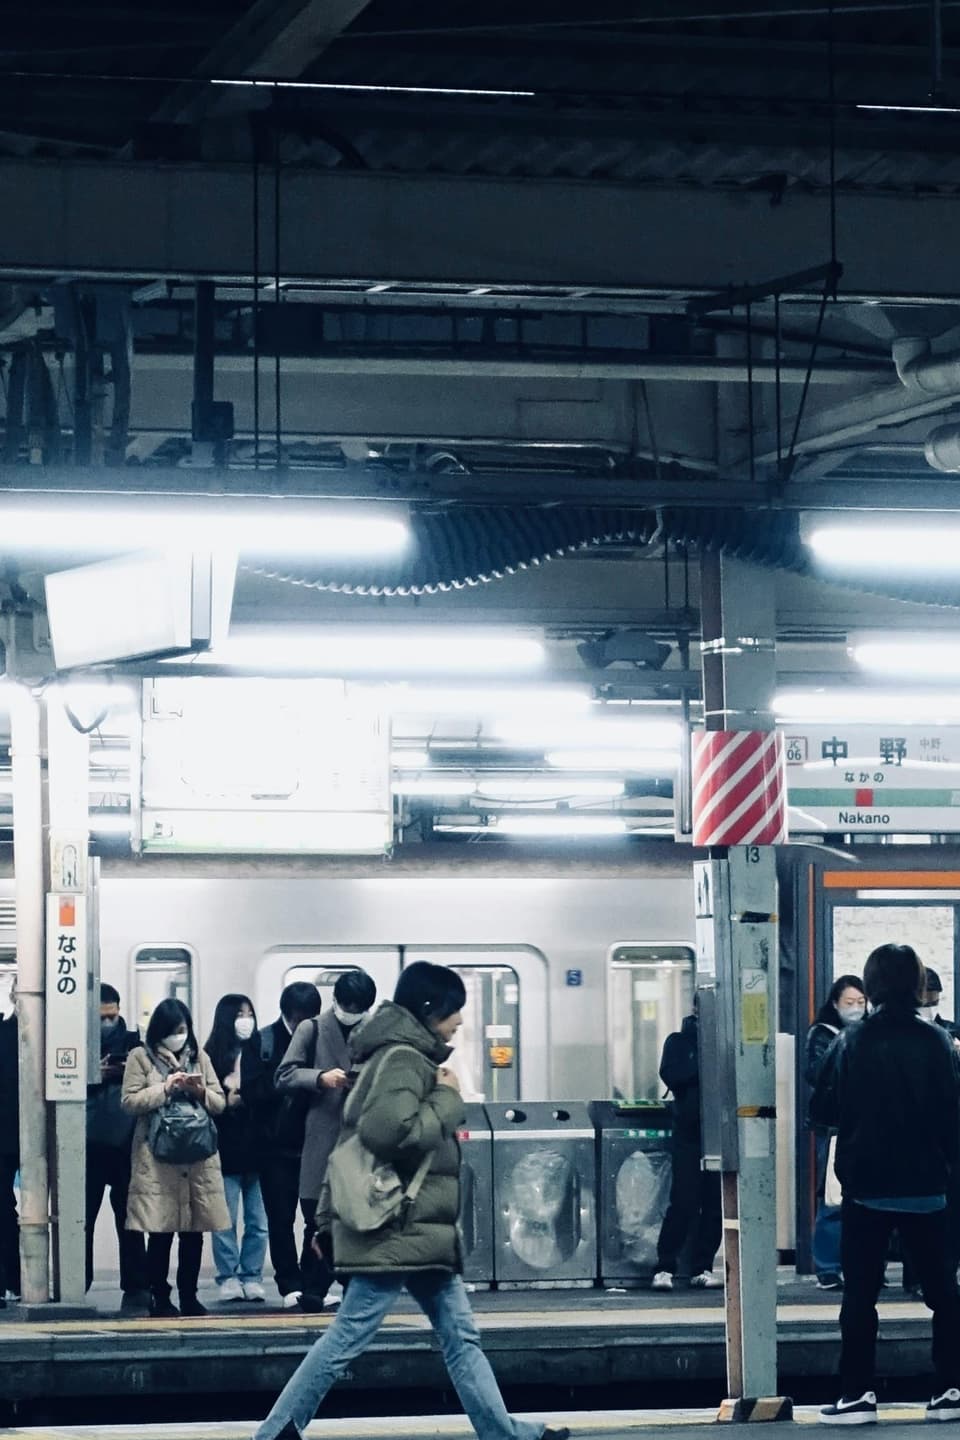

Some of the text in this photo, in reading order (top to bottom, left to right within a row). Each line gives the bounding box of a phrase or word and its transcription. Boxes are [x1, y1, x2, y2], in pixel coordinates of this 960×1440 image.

[787, 750, 801, 761] 06
[821, 736, 907, 766] 中野
[844, 772, 885, 783] なかの
[838, 812, 890, 824] Nakano
[745, 846, 760, 863] 13
[57, 934, 77, 995] なかの
